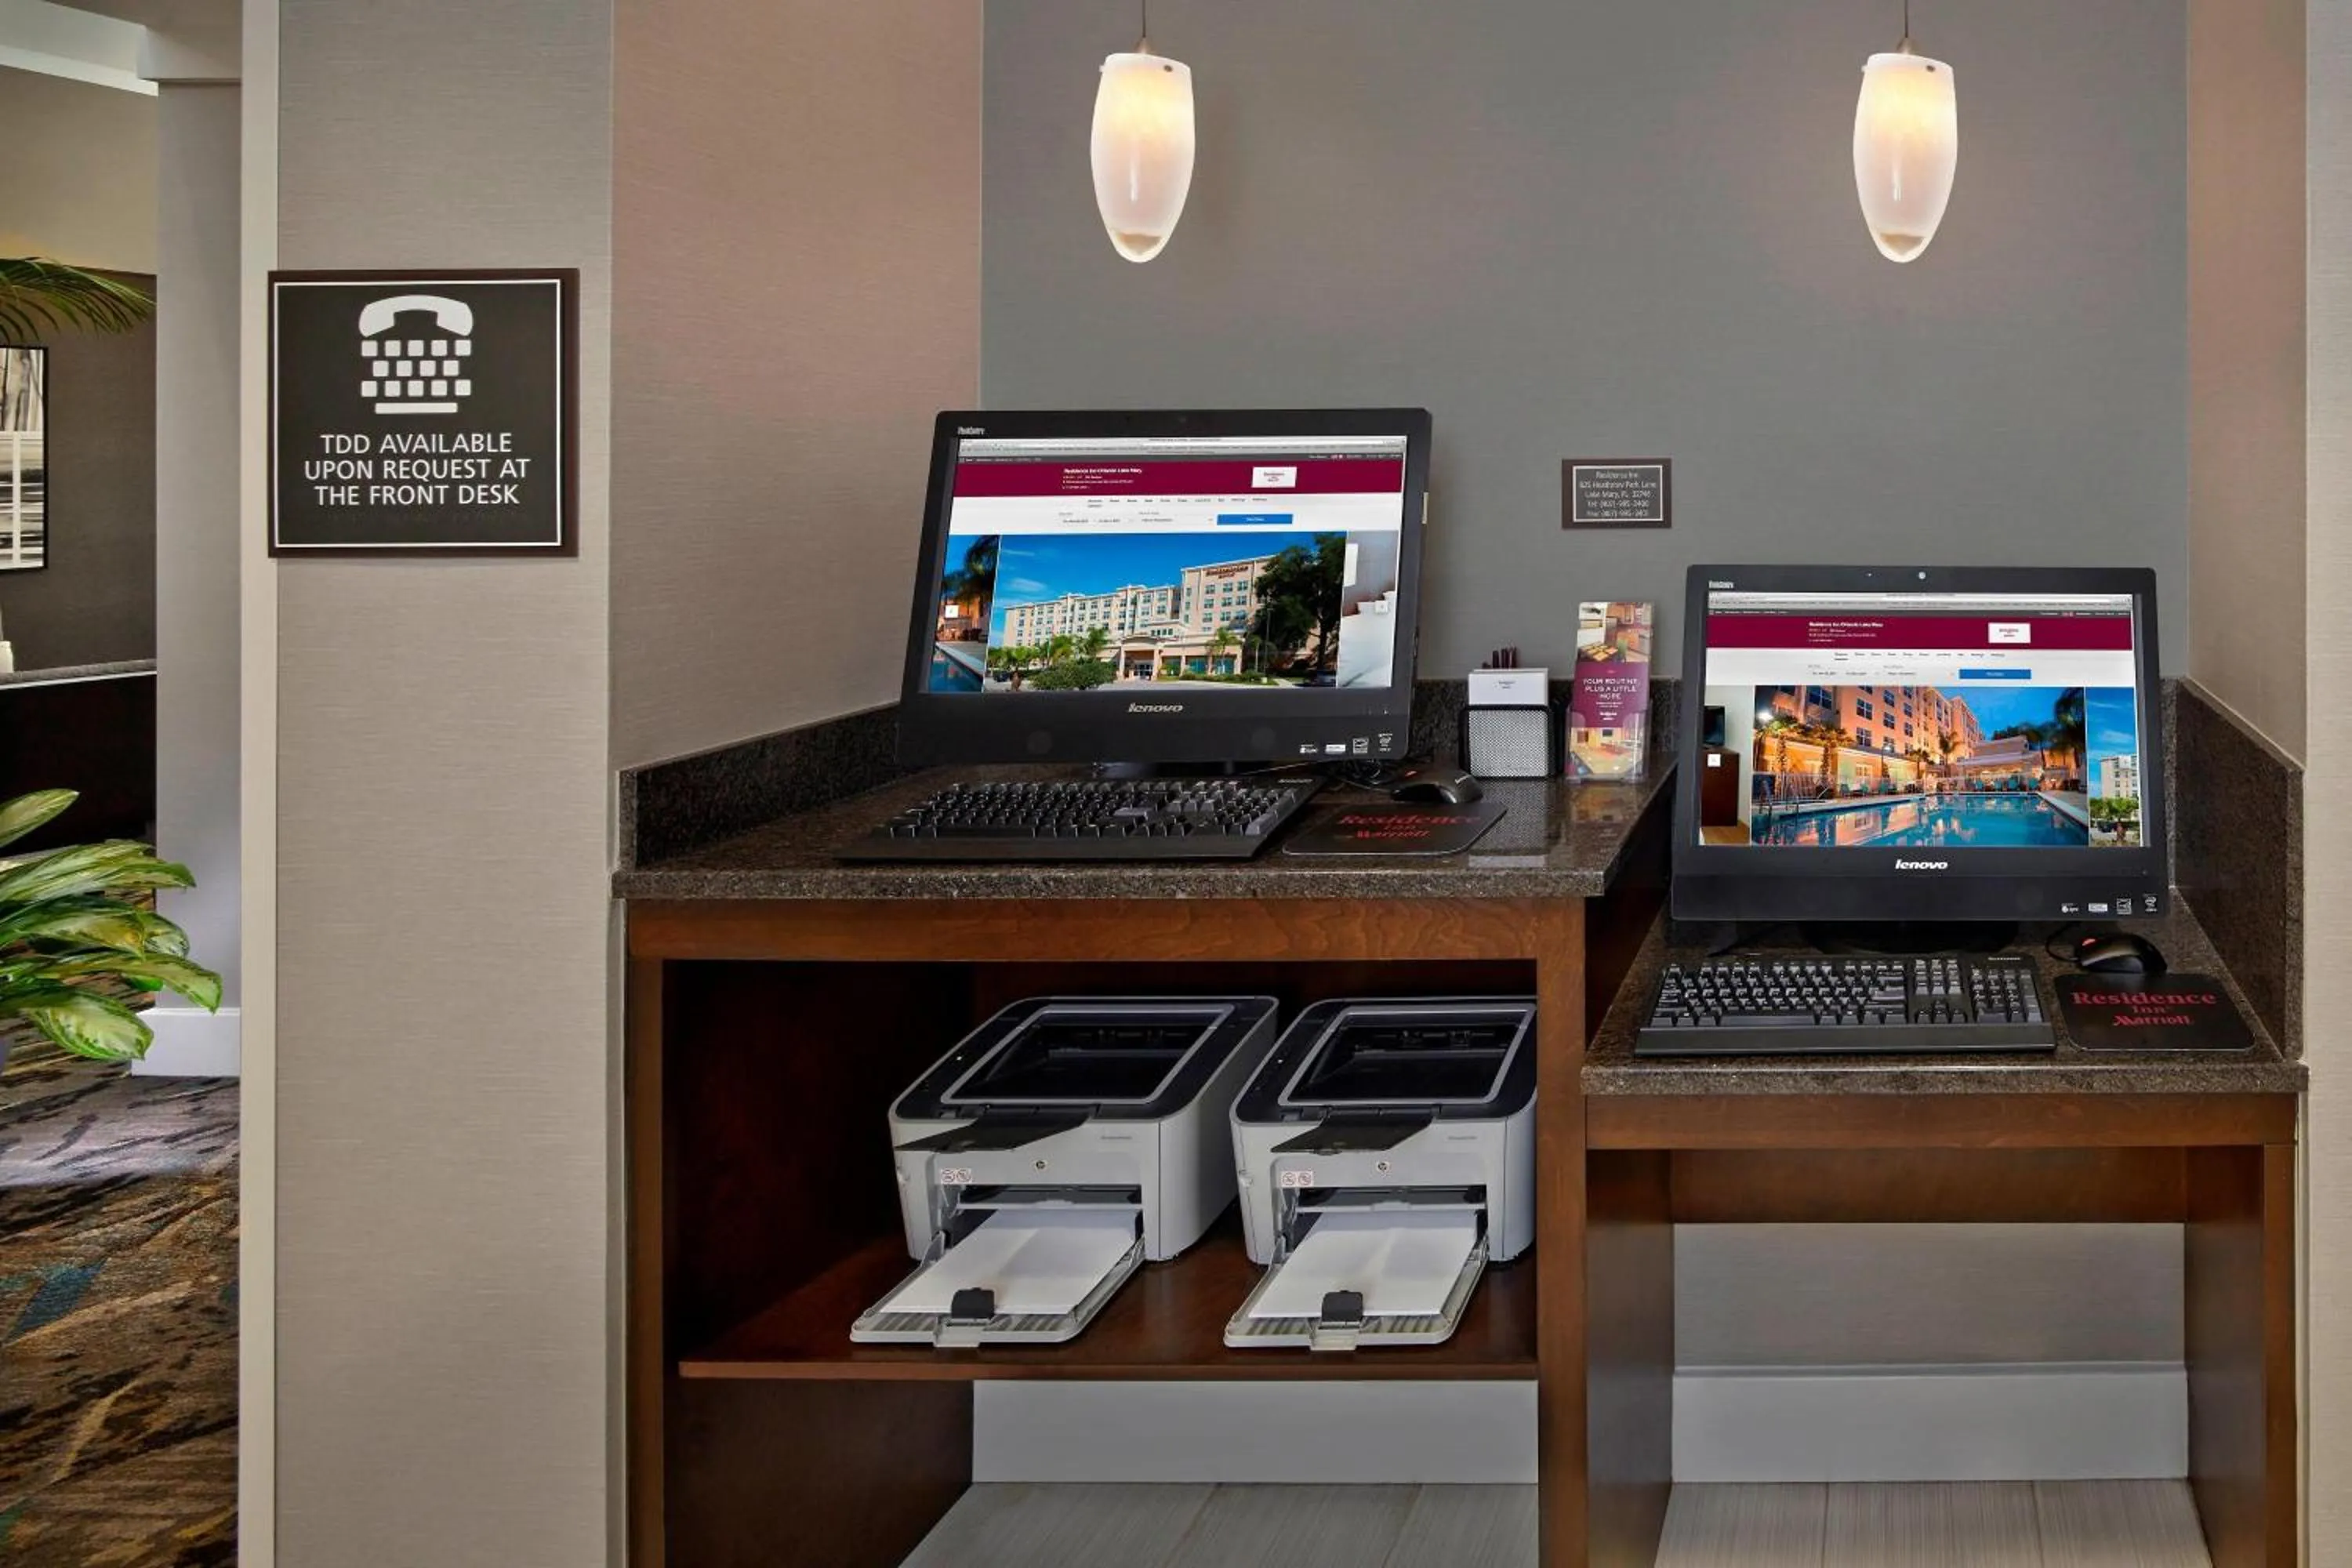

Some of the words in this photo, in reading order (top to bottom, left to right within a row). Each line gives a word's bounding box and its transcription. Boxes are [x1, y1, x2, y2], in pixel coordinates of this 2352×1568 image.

[320, 434, 371, 454] TDD
[379, 433, 513, 454] AVAILABLE
[304, 459, 372, 480] UPON
[383, 459, 492, 482] REQUEST
[499, 459, 532, 478] AT
[314, 485, 360, 505] THE
[370, 485, 450, 505] FRONT
[459, 484, 521, 504] DESK
[1127, 702, 1183, 713] lenovo
[1894, 858, 1948, 869] lenovo
[2071, 991, 2217, 1005] Residence
[2131, 1005, 2165, 1014] Inn
[2112, 1014, 2193, 1027] Marriott
